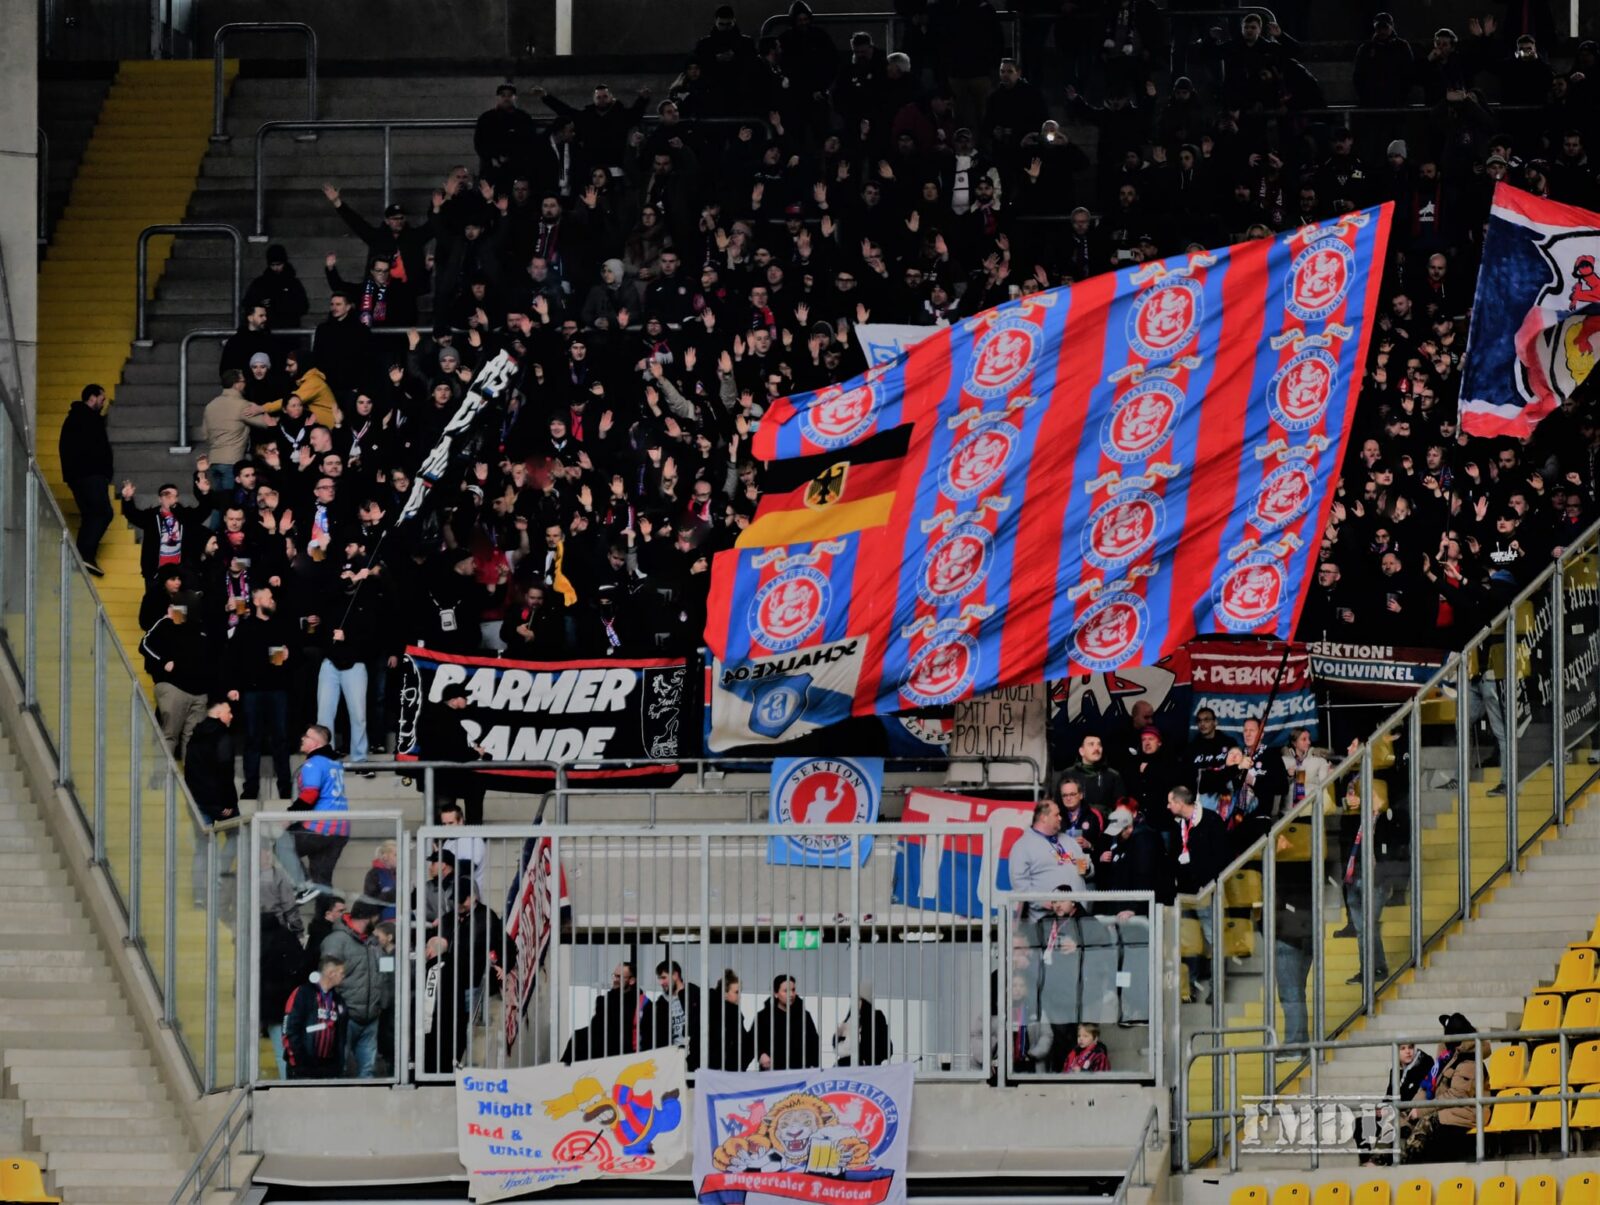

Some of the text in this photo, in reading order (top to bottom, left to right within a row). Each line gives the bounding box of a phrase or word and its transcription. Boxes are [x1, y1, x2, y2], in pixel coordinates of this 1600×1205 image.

[1312, 641, 1384, 659] SEKTION
[1210, 665, 1297, 686] DEBAKEL
[1312, 659, 1414, 681] VOHWINKEL
[956, 701, 1013, 726] DATT IS
[792, 761, 862, 788] SEKTION
[463, 1076, 509, 1094] Good
[478, 1101, 532, 1119] Night
[467, 1123, 523, 1142] Red &
[489, 1144, 542, 1158] White
[811, 1180, 872, 1200] Patrioten
